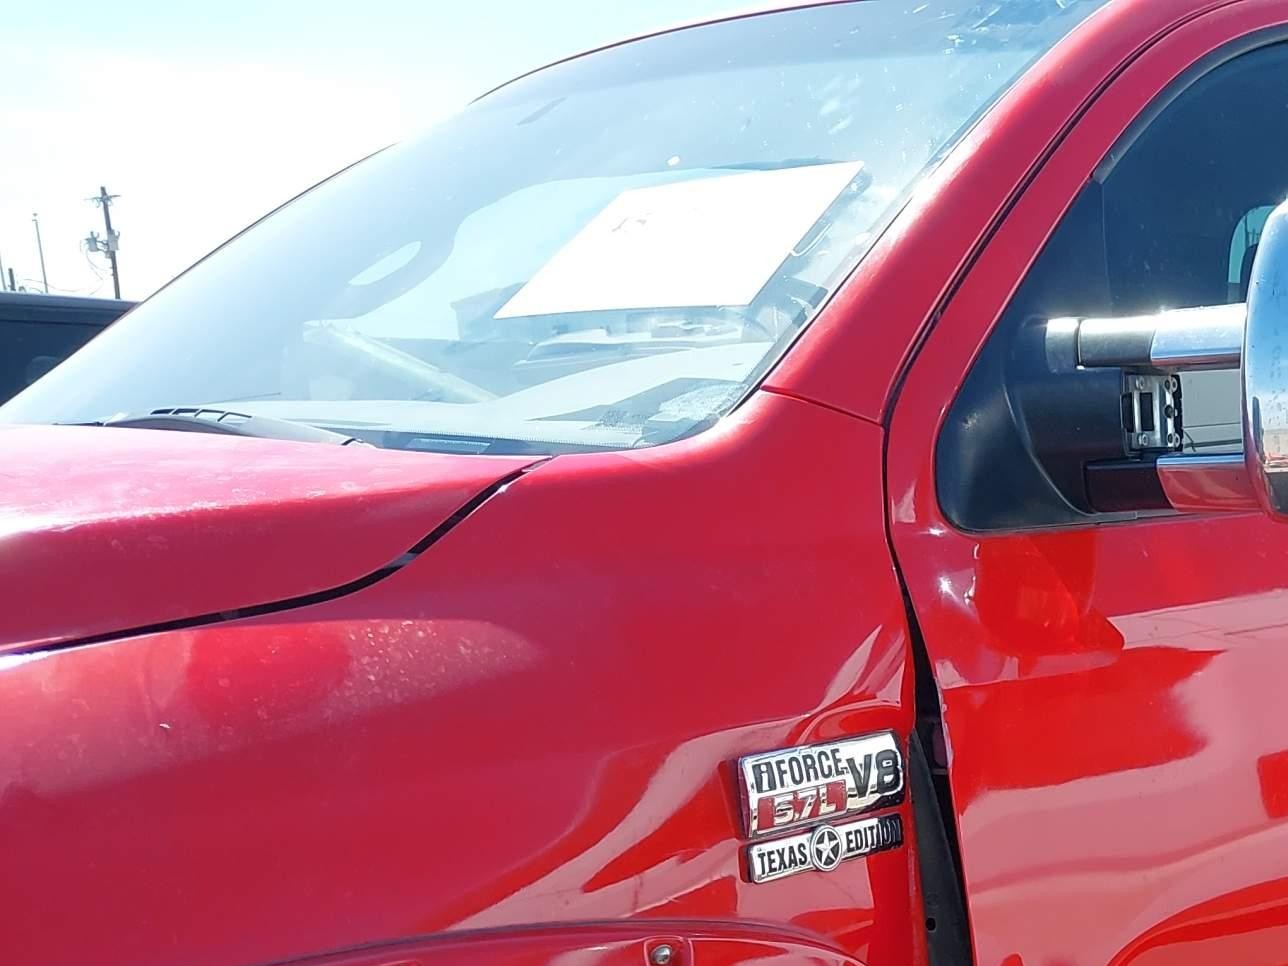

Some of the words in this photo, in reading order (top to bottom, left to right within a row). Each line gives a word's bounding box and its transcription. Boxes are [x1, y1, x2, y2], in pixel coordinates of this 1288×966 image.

[846, 749, 902, 799] V8
[757, 845, 808, 877] TEXAS
[845, 818, 902, 853] EDITION
